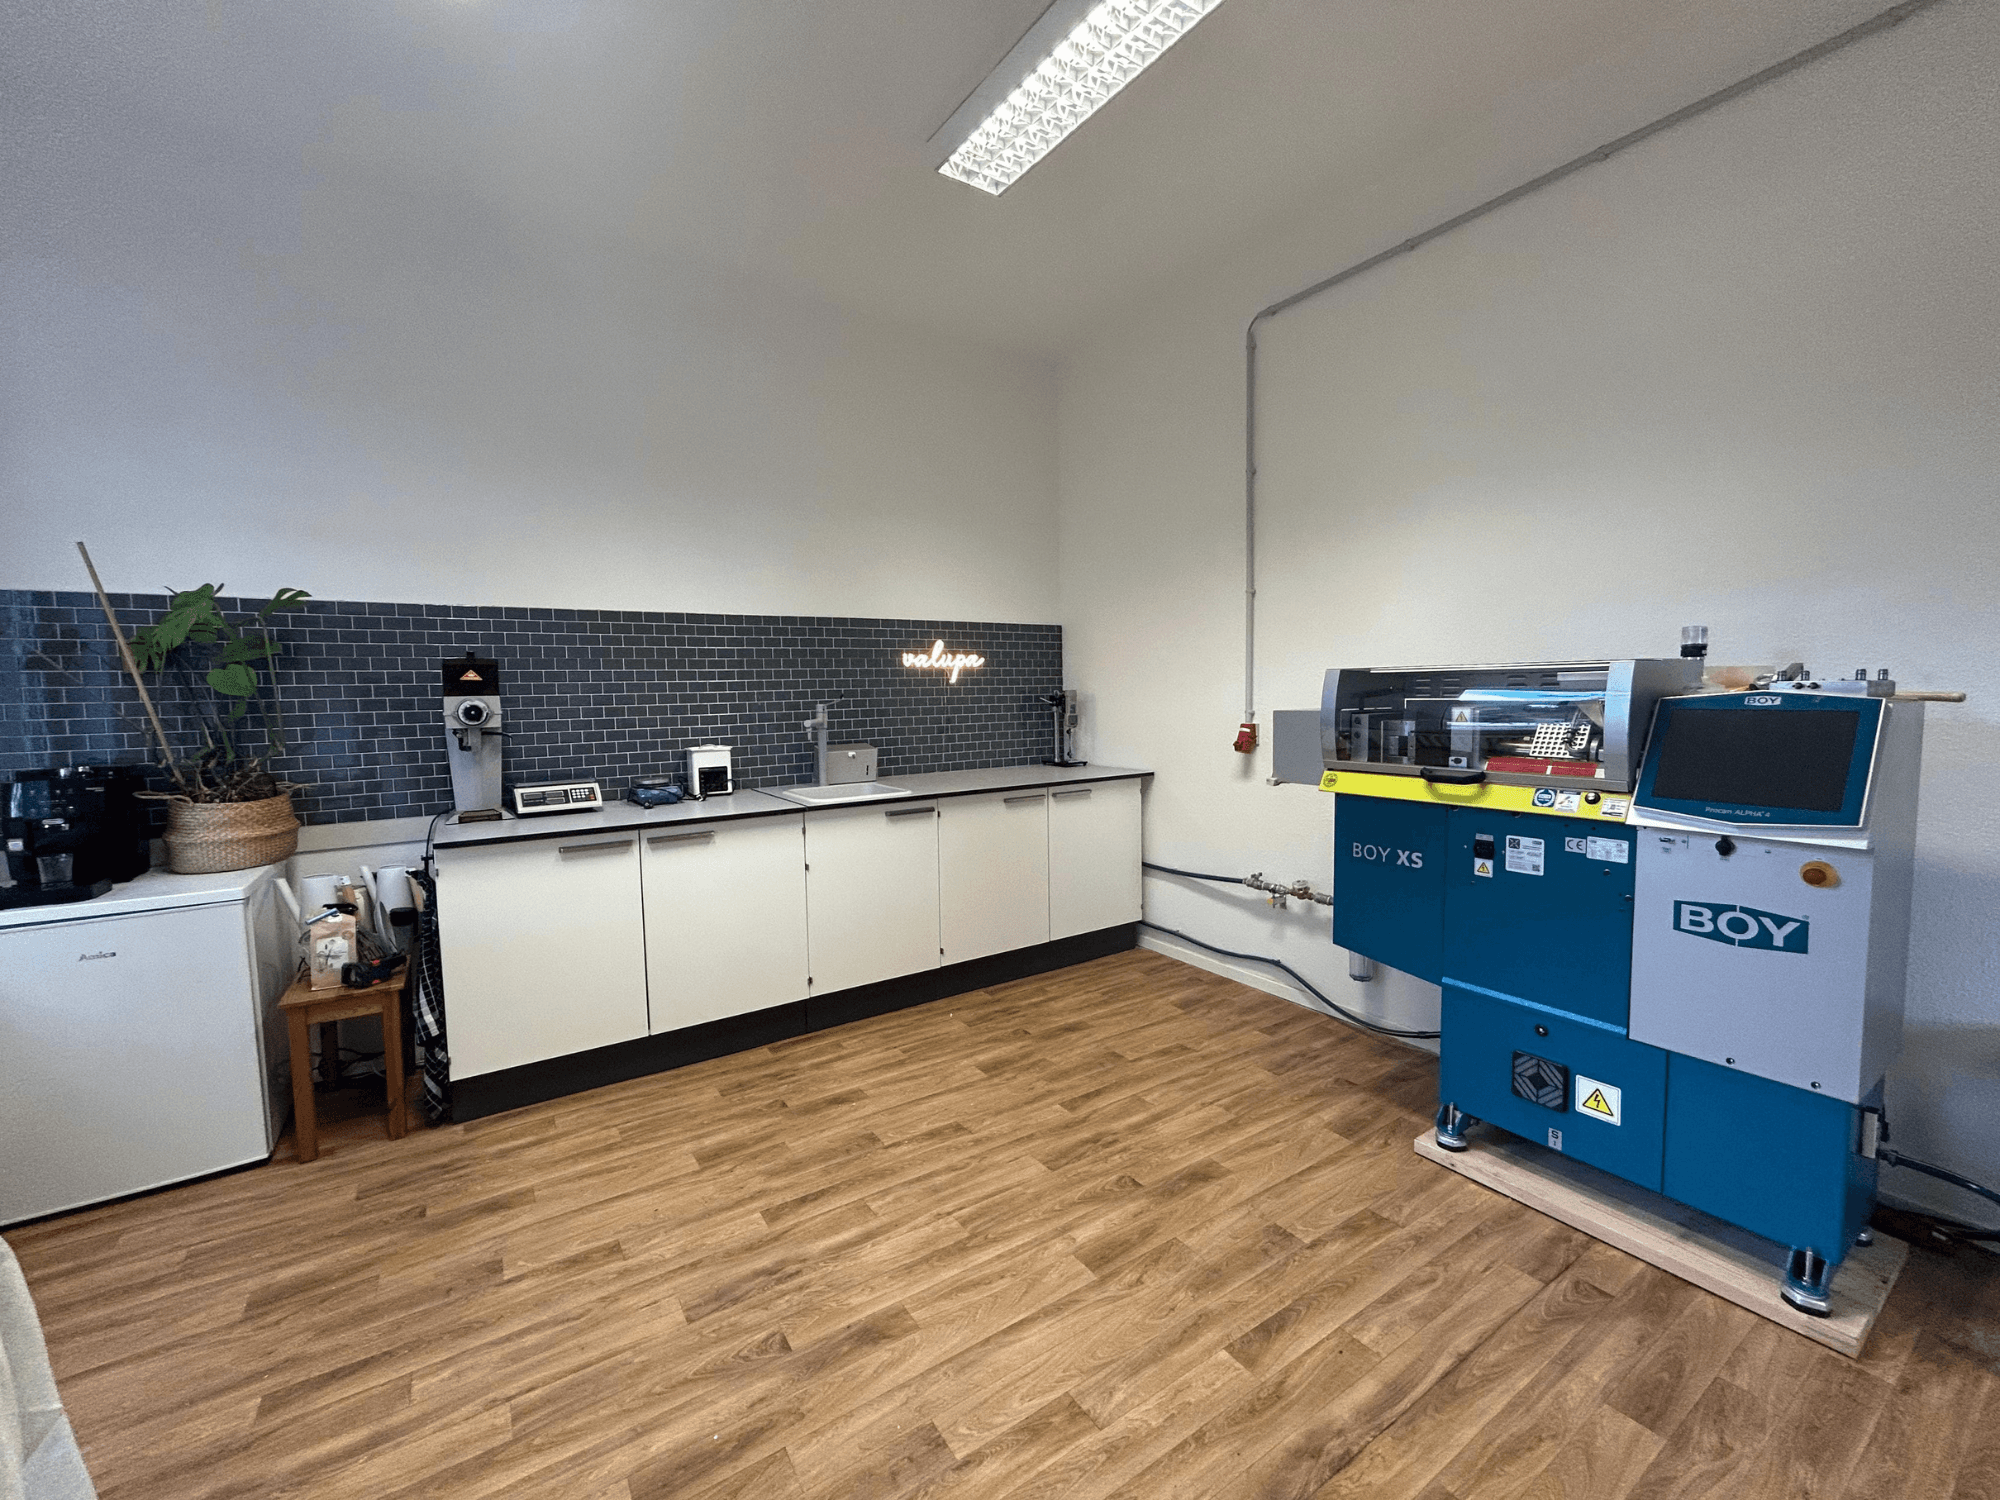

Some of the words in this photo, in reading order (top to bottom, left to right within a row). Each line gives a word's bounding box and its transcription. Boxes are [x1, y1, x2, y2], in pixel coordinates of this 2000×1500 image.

[902, 639, 985, 684] valupa
[1352, 842, 1391, 862] BOY
[1396, 849, 1423, 869] XS
[1679, 903, 1801, 948] BOY
